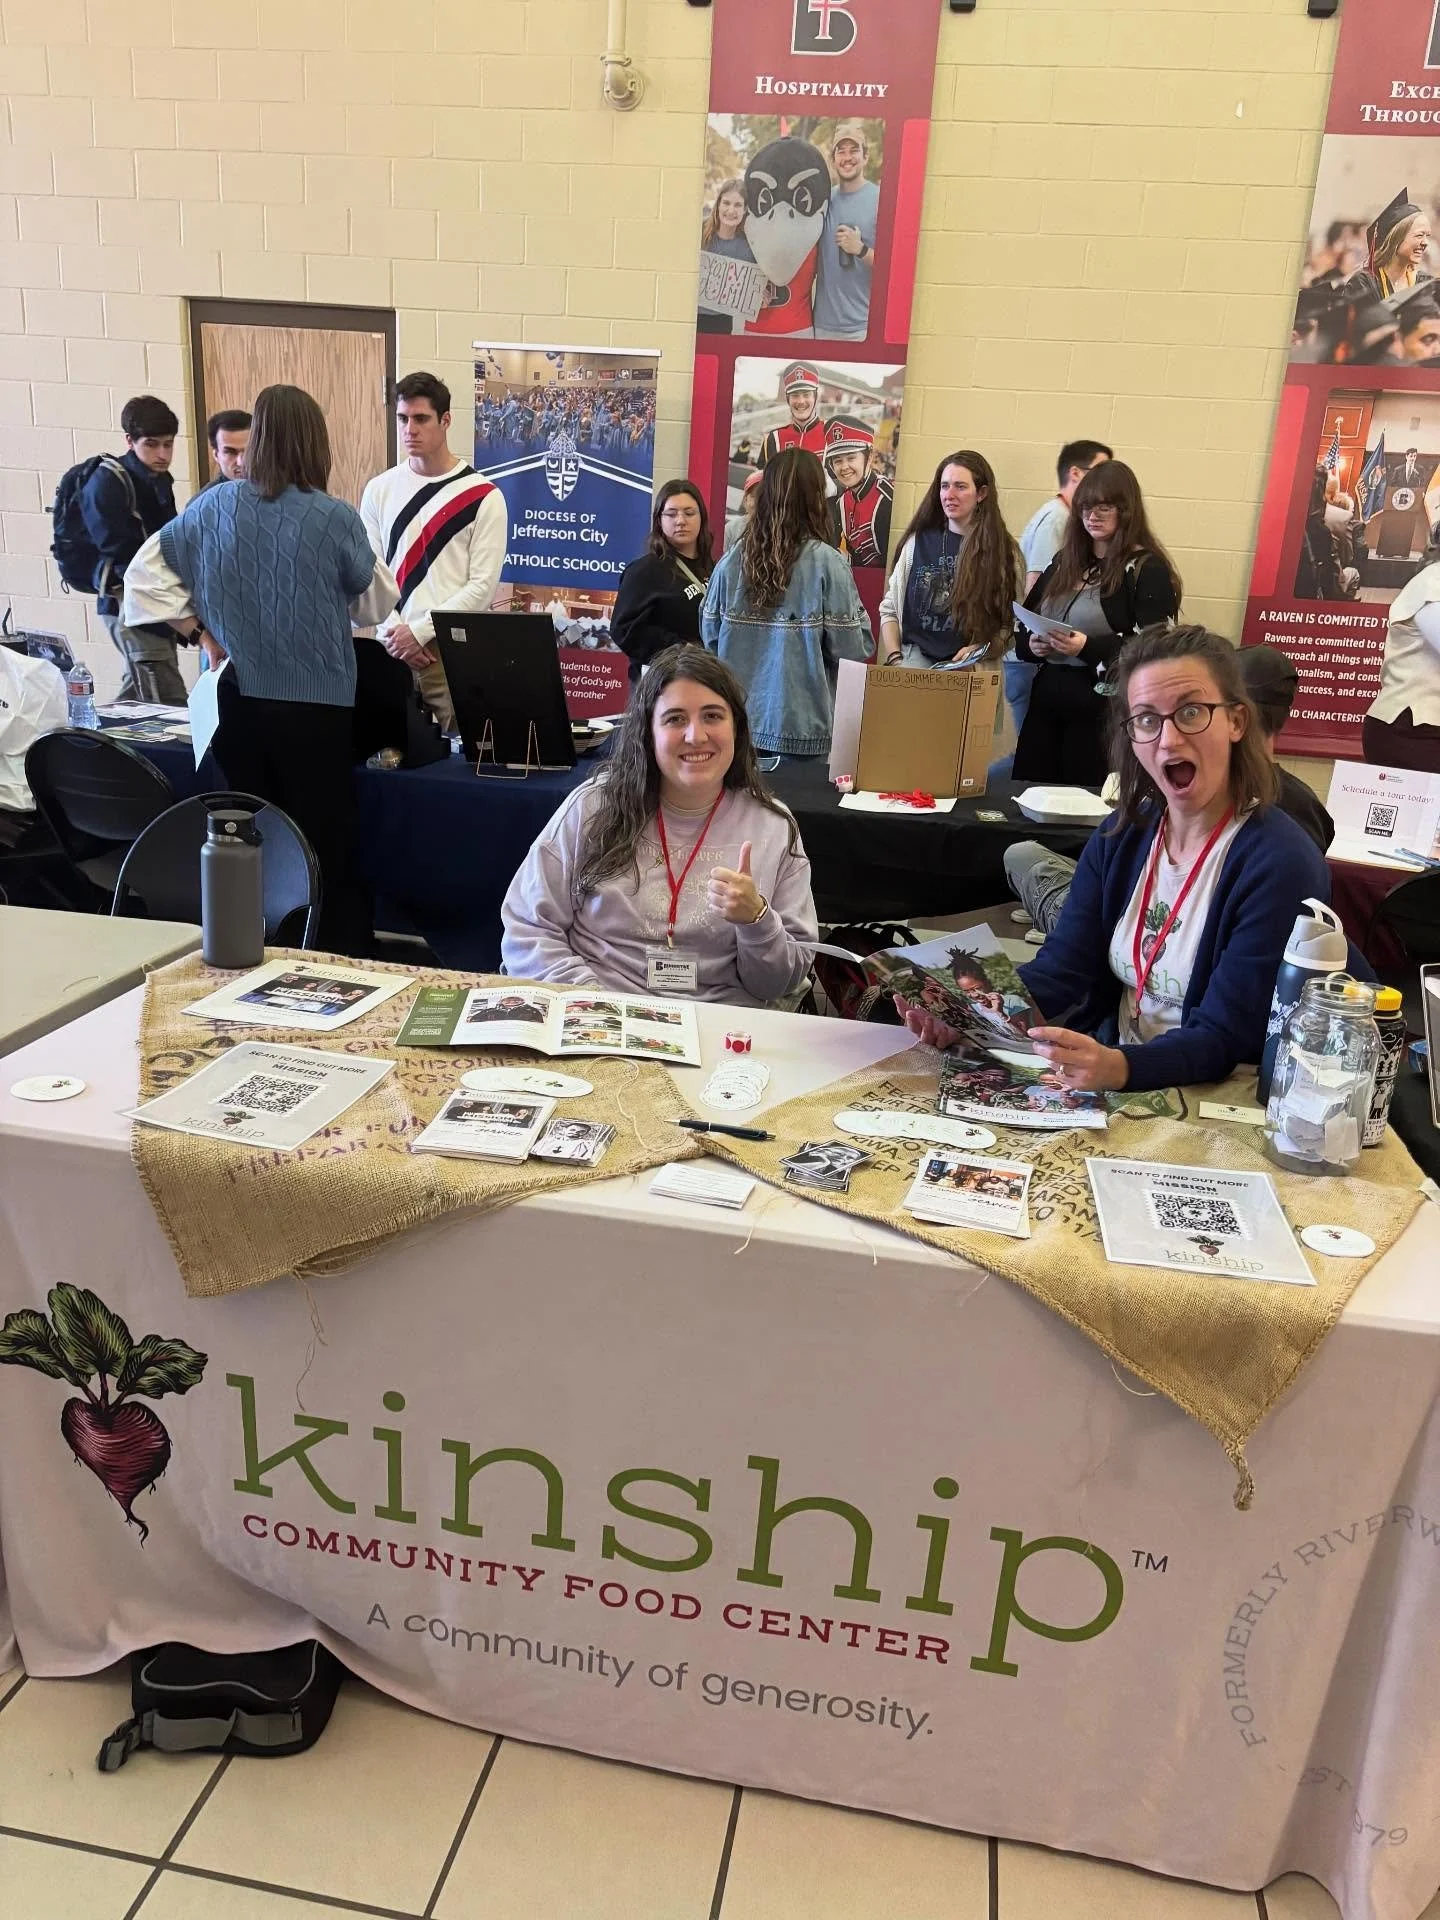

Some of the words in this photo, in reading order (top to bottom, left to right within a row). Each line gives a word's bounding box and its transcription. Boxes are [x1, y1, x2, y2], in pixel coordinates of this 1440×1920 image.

[755, 76, 888, 98] HOSPITALITY
[525, 509, 576, 523] DIOCESE
[580, 513, 597, 524] OF
[511, 523, 577, 540] Jefferson
[580, 528, 609, 546] City
[503, 553, 560, 568] ATHOLIC
[562, 558, 626, 574] SCHOOLS
[1259, 611, 1267, 621] A
[1269, 611, 1303, 623] RAVEN
[1305, 613, 1315, 624] IS
[1317, 614, 1379, 628] COMMITTED
[1264, 632, 1296, 645] Ravens
[1298, 635, 1313, 645] are
[1314, 636, 1365, 649] committed
[1367, 638, 1377, 649] to
[560, 661, 591, 672] tudents
[592, 664, 601, 673] to
[602, 665, 612, 674] be
[1317, 653, 1330, 664] all
[1331, 653, 1361, 666] things
[1363, 655, 1384, 666] with
[571, 676, 580, 686] of
[581, 676, 603, 687] God's
[604, 679, 622, 690] gifts
[904, 671, 943, 687] SUMMER
[1337, 671, 1356, 681] and
[572, 690, 606, 700] another
[1298, 685, 1335, 697] success,
[1337, 687, 1355, 697] and
[1341, 784, 1378, 797] Schedule
[1387, 792, 1406, 801] tour
[272, 1062, 329, 1077] MISSION
[1111, 1168, 1142, 1177] SCAN
[1163, 1174, 1189, 1182] FIND
[1191, 1176, 1214, 1185] OUT
[1217, 1180, 1249, 1188] MORE
[1152, 1180, 1217, 1193] MISSION
[1164, 1249, 1265, 1273] kinship
[226, 1372, 1124, 1678] kinship
[1131, 1549, 1170, 1574] TM
[243, 1513, 546, 1593] COMMUNITY
[563, 1575, 702, 1621] FOOD
[722, 1602, 951, 1666] CENTER
[1223, 1561, 1289, 1748] FORMERLY
[366, 1603, 391, 1630] A
[403, 1613, 636, 1689] community
[648, 1661, 690, 1691] of
[701, 1671, 935, 1741] generosity.
